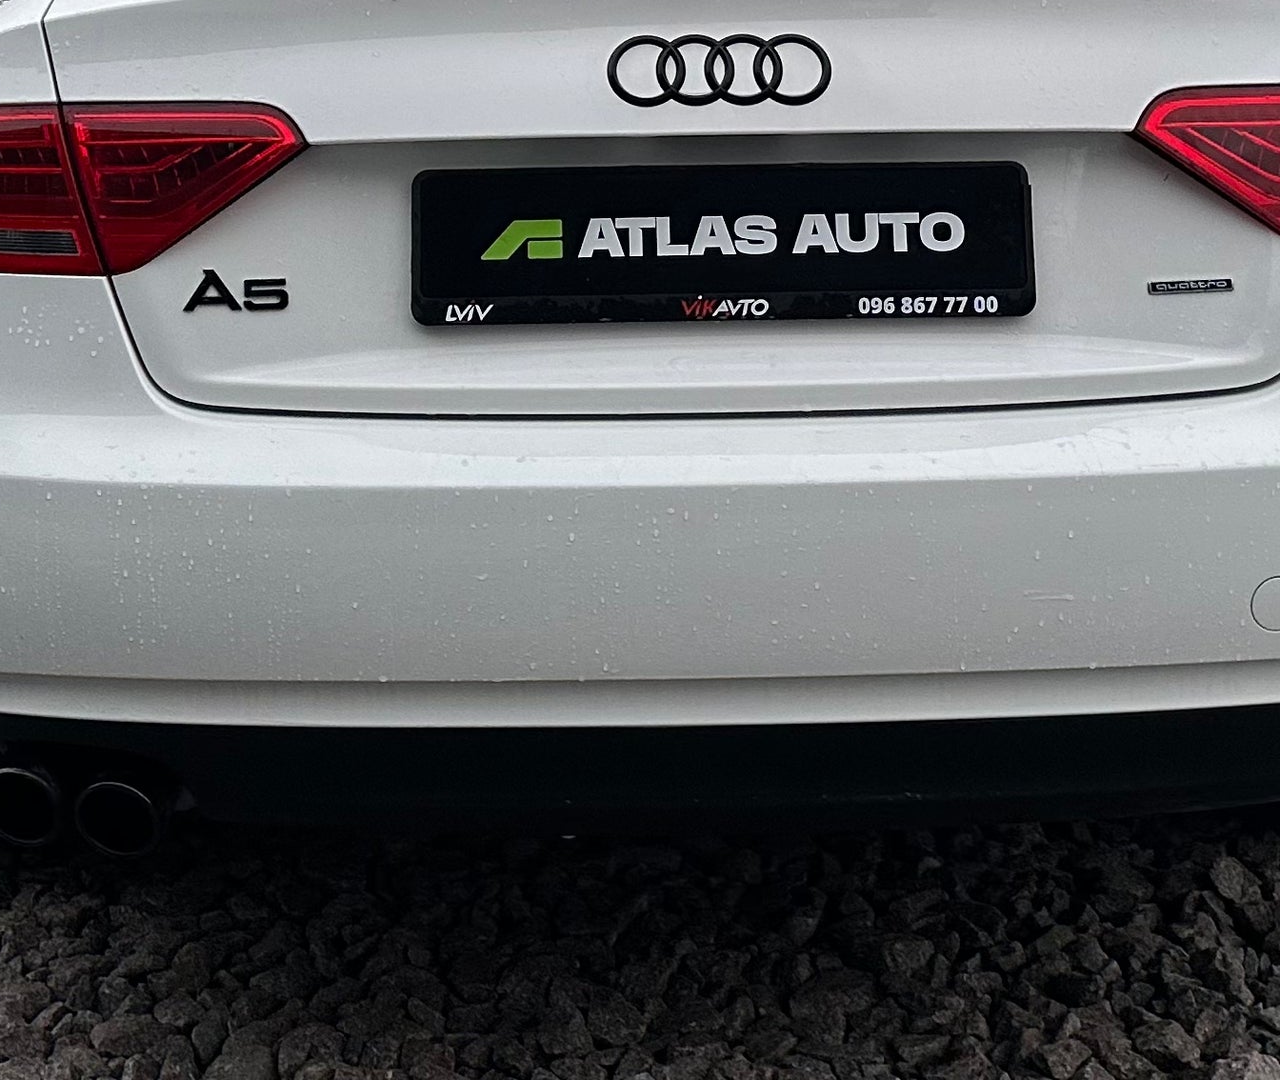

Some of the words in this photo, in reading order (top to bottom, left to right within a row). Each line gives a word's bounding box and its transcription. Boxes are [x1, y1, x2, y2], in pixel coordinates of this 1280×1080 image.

[577, 215, 778, 258] ATLAS
[792, 211, 965, 254] AUTO
[182, 269, 289, 312] A5
[1155, 280, 1228, 291] quattro
[858, 296, 896, 314] 096
[900, 296, 938, 314] 867
[943, 296, 968, 313] 77
[973, 295, 999, 313] 00
